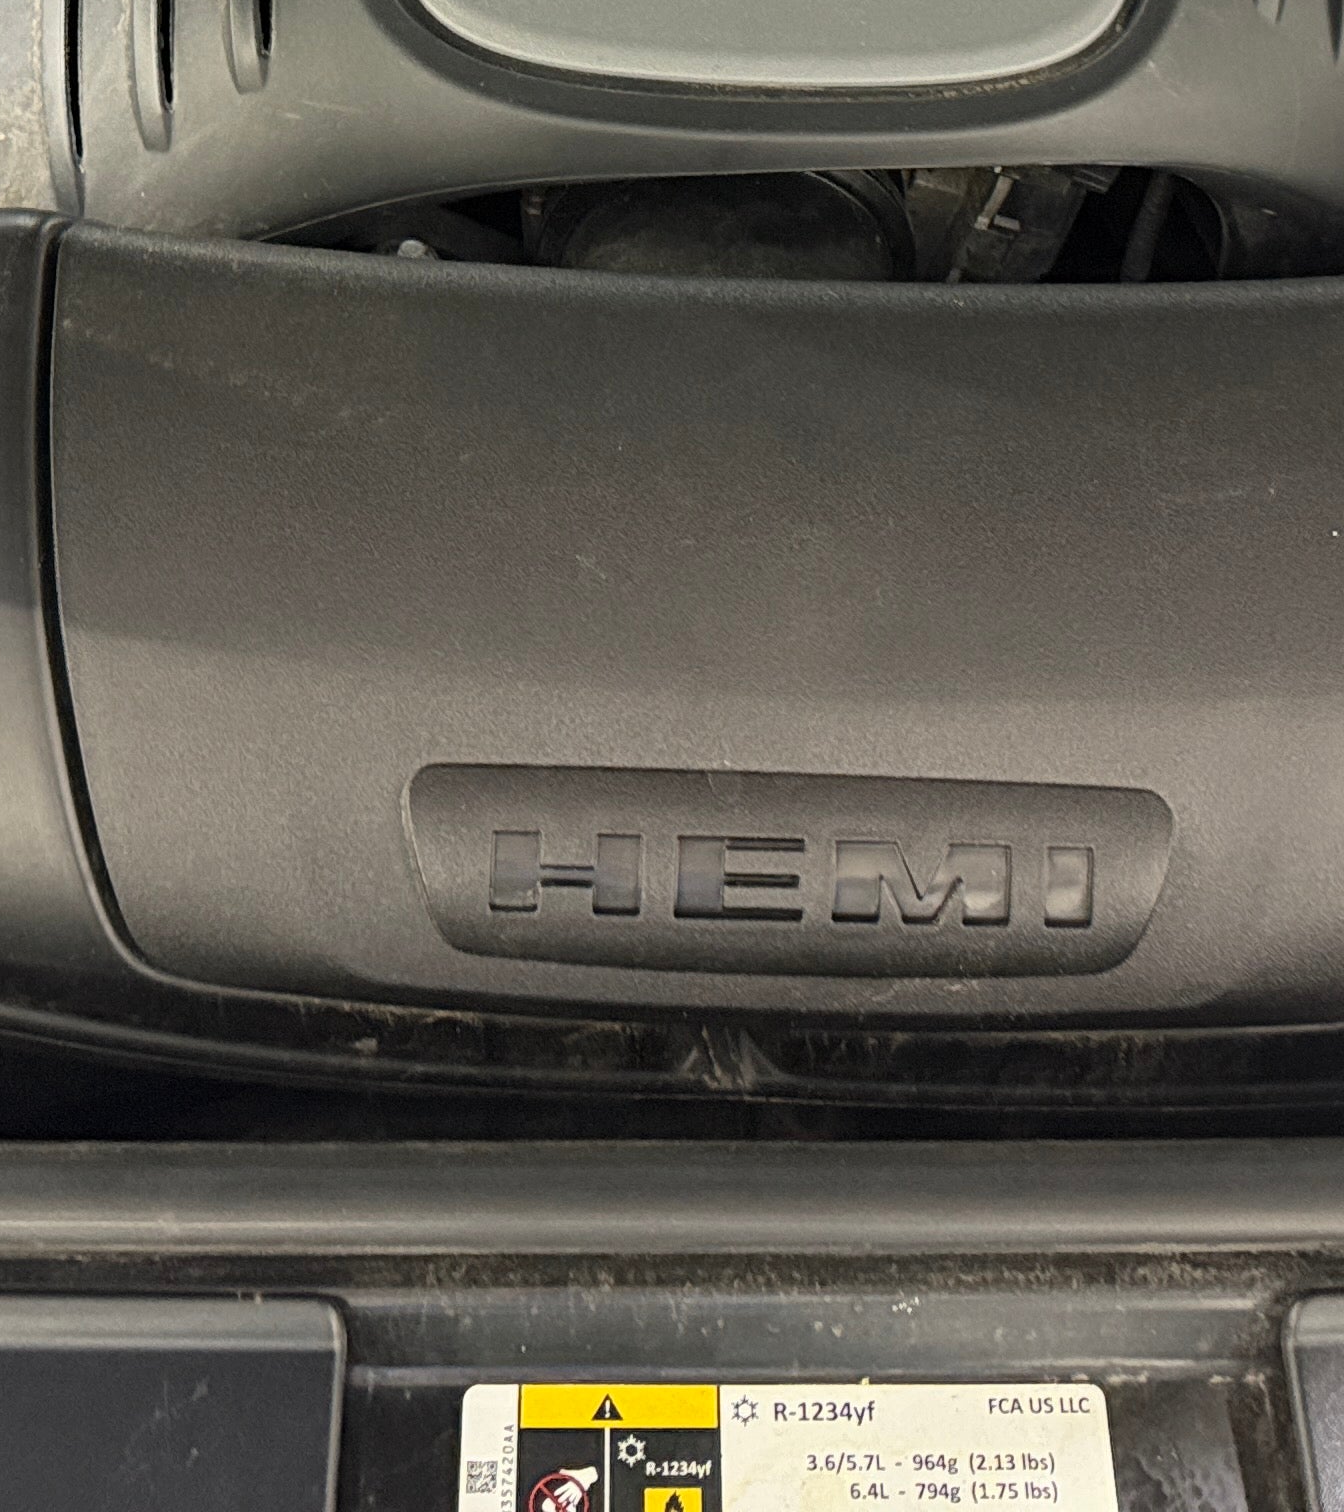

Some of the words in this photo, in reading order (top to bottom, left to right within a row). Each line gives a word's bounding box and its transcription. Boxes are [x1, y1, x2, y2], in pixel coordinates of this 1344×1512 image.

[488, 828, 1094, 929] HEMI
[773, 1400, 876, 1426] R-1234yf
[988, 1397, 1023, 1414] FCA
[1029, 1397, 1053, 1414] US
[1059, 1397, 1090, 1414] LLC
[645, 1460, 713, 1479] R-1234yf
[806, 1452, 886, 1475] 3.6/5.7L
[912, 1454, 959, 1475] 964g
[969, 1452, 1016, 1475] (2.13
[1022, 1452, 1056, 1475] lbs)
[850, 1483, 889, 1501] 6.4L
[915, 1483, 961, 1504] 794g
[971, 1481, 1019, 1504] (1.75
[1025, 1481, 1059, 1504] lbs)
